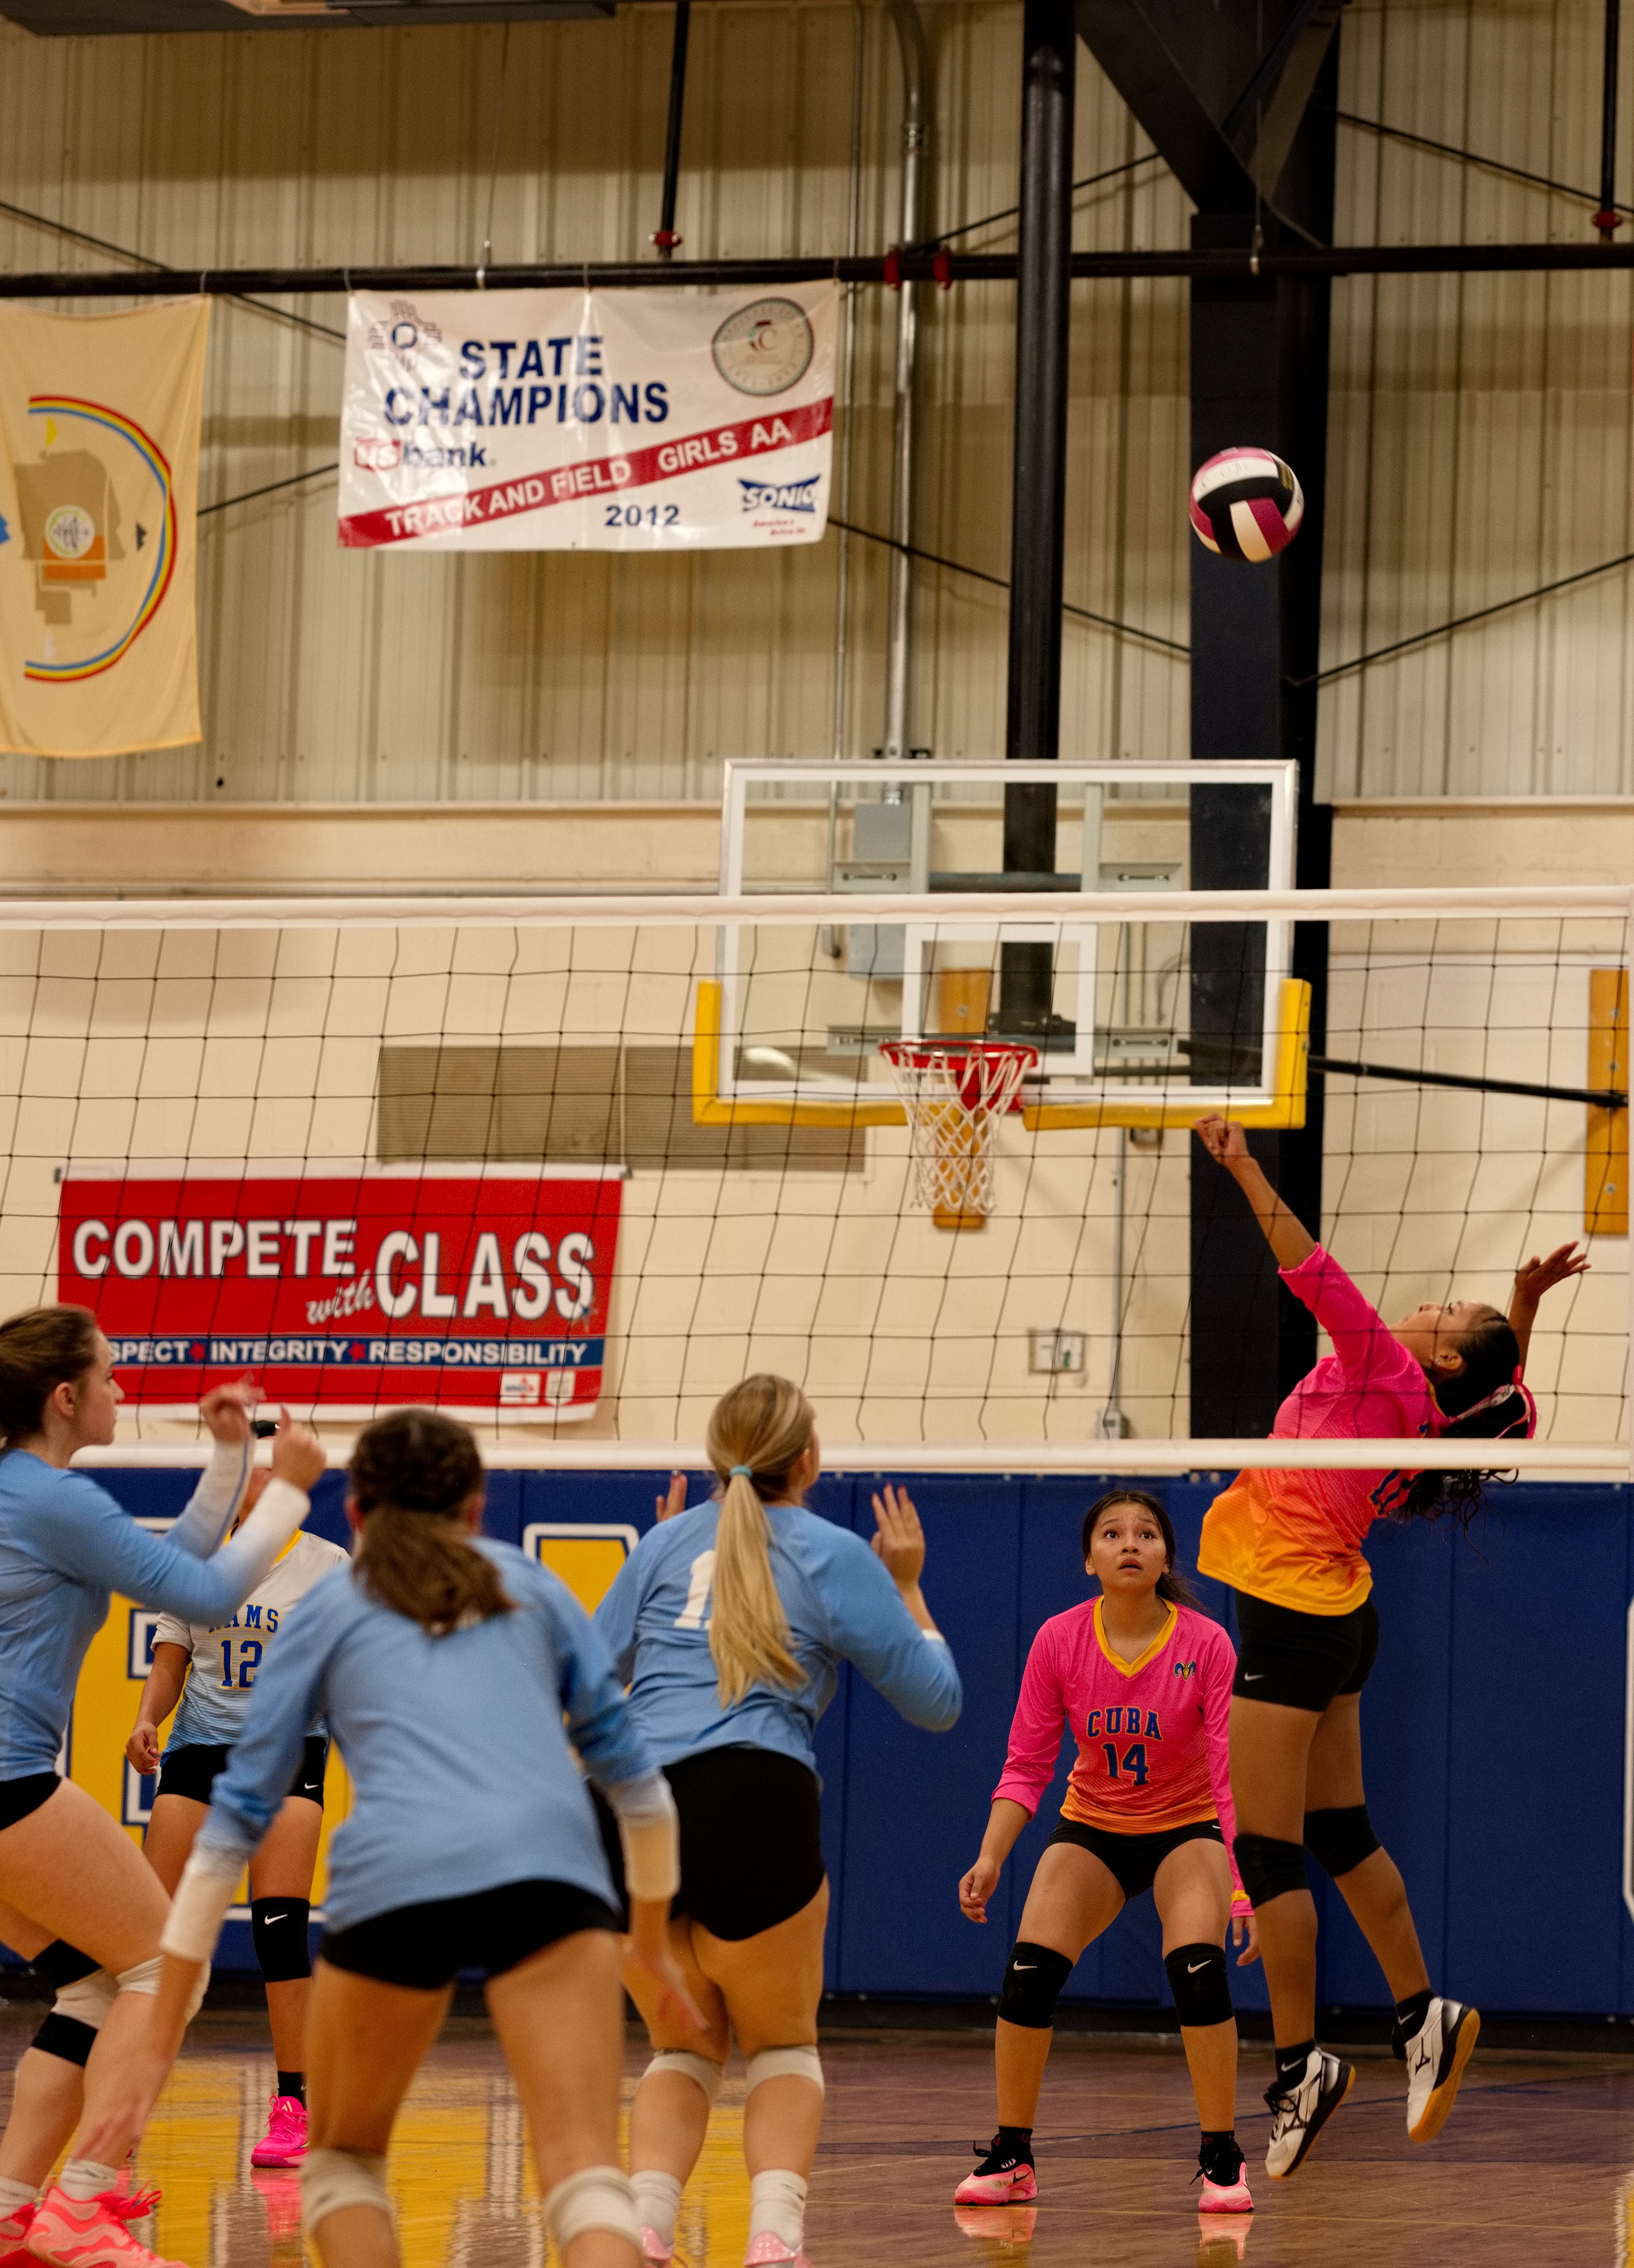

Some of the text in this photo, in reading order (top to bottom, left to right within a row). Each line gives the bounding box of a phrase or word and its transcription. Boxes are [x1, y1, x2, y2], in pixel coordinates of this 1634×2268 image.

[459, 336, 603, 380] STATE
[384, 383, 669, 426] CHAMPIONS
[385, 419, 792, 536] TRACK AND FIELD GIRLS AA
[743, 483, 815, 510] SONIC
[604, 504, 680, 527] 2012
[72, 1219, 595, 1326] COMPETE with CLASS
[110, 1339, 587, 1364] SPECT INTEGRITY RESPONSIBILITY
[674, 1549, 717, 1628] 1
[220, 1638, 264, 1689] 12
[1087, 1706, 1164, 1742] CUBA
[1101, 1742, 1150, 1787] 14
